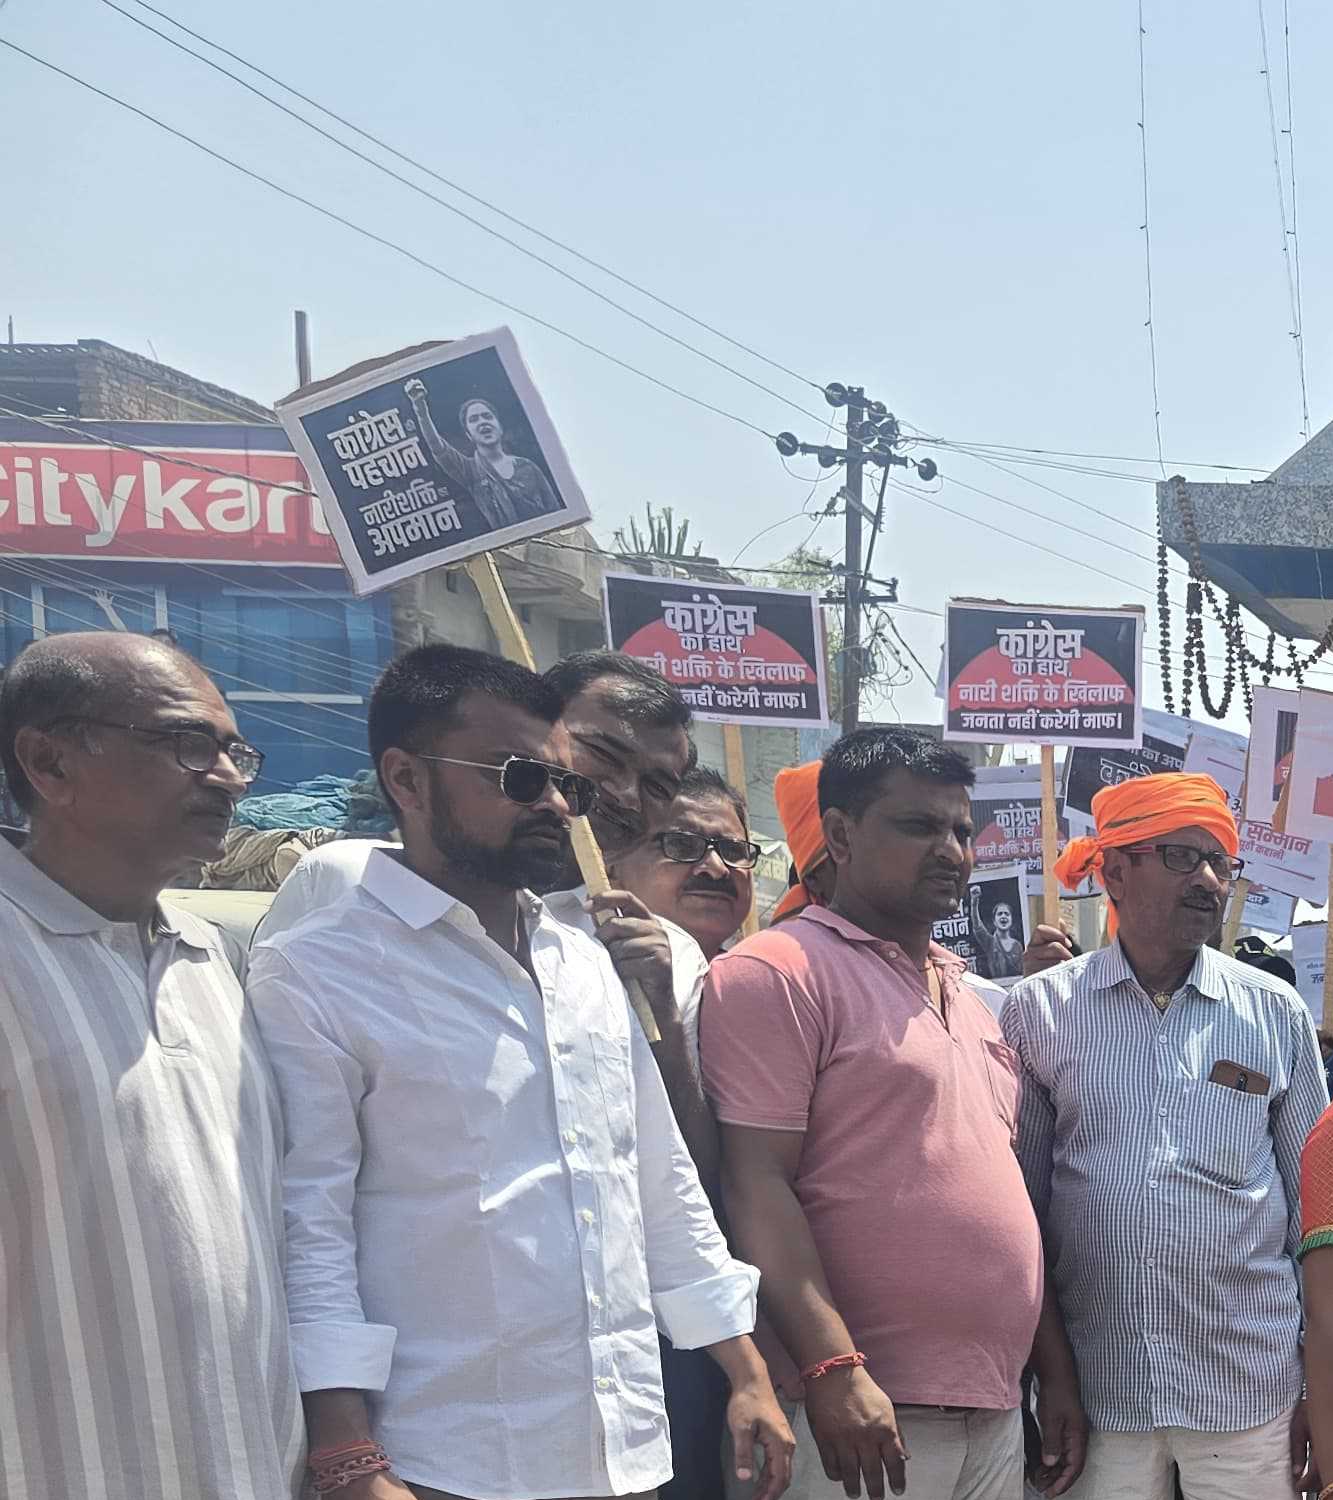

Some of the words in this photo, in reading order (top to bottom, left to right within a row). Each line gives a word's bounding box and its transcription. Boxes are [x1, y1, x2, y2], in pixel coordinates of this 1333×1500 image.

[327, 408, 406, 460] कांग्रेस
[342, 436, 428, 490] पहचान
[367, 499, 463, 556] अपमान
[661, 593, 758, 637] कांग्रेस
[680, 632, 704, 652] का
[996, 619, 1086, 659] कांग्रेस
[671, 654, 713, 679] शक्ति
[713, 656, 738, 681] के
[739, 657, 808, 681] खिलाफ
[1010, 657, 1034, 677] का
[716, 685, 760, 709] करेगी
[957, 677, 998, 703] नारी
[1001, 678, 1041, 703] शक्ति
[1041, 679, 1061, 703] के
[1060, 679, 1127, 704] खिलाफ
[960, 712, 1006, 730] जनता
[1006, 708, 1040, 730] नहीं
[1039, 709, 1081, 730] करेगी
[1247, 821, 1313, 856] सम्मान
[931, 915, 970, 941] हचान
